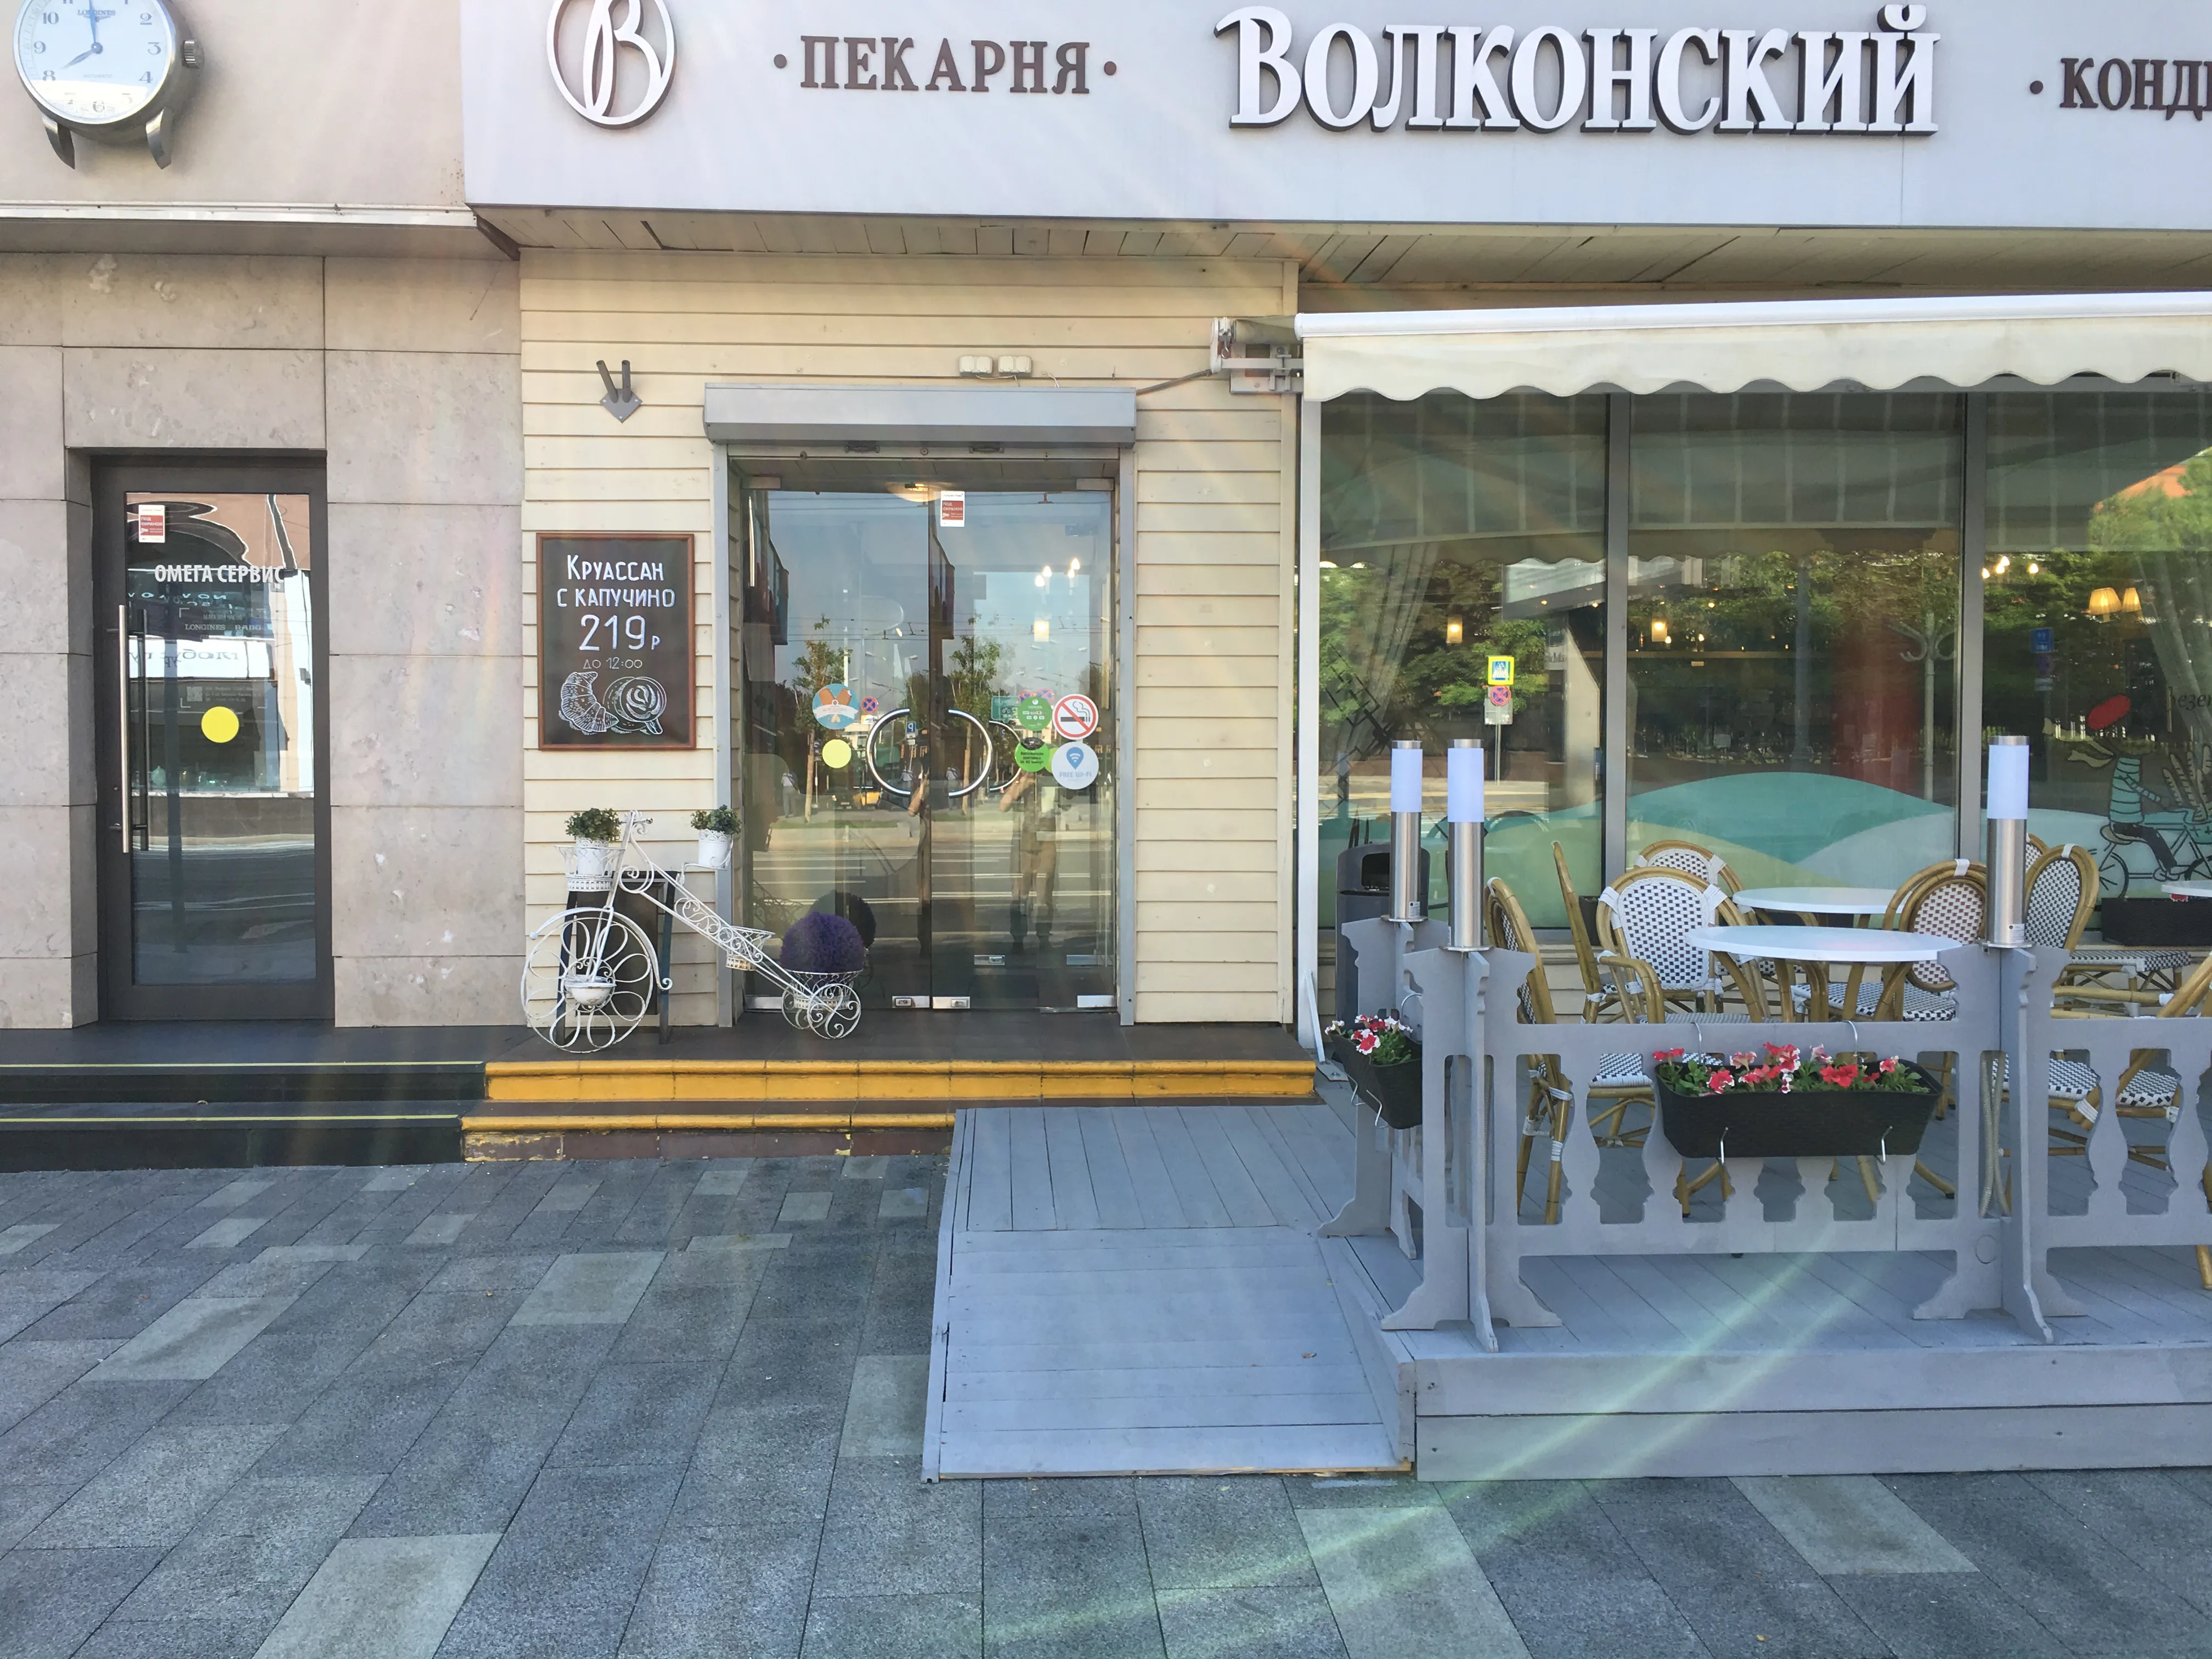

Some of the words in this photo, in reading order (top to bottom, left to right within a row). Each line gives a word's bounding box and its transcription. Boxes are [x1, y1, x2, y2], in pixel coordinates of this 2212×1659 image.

[42, 12, 59, 25] 10
[139, 13, 153, 25] 2
[33, 41, 47, 54] 9
[147, 42, 161, 55] 3
[800, 35, 1090, 94] ПЕКАРНЯ
[1215, 3, 1940, 137] ВОЛКОНСКИЙ
[42, 70, 56, 82] 8
[138, 71, 153, 83] 4
[92, 100, 105, 113] 6
[154, 565, 213, 583] ОМЕГА
[217, 565, 285, 583] СЕРВИС
[567, 554, 664, 581] КРУАССАН
[575, 588, 675, 608] КАПУЧИНО
[579, 614, 645, 651] 219
[606, 656, 643, 670] 12:00
